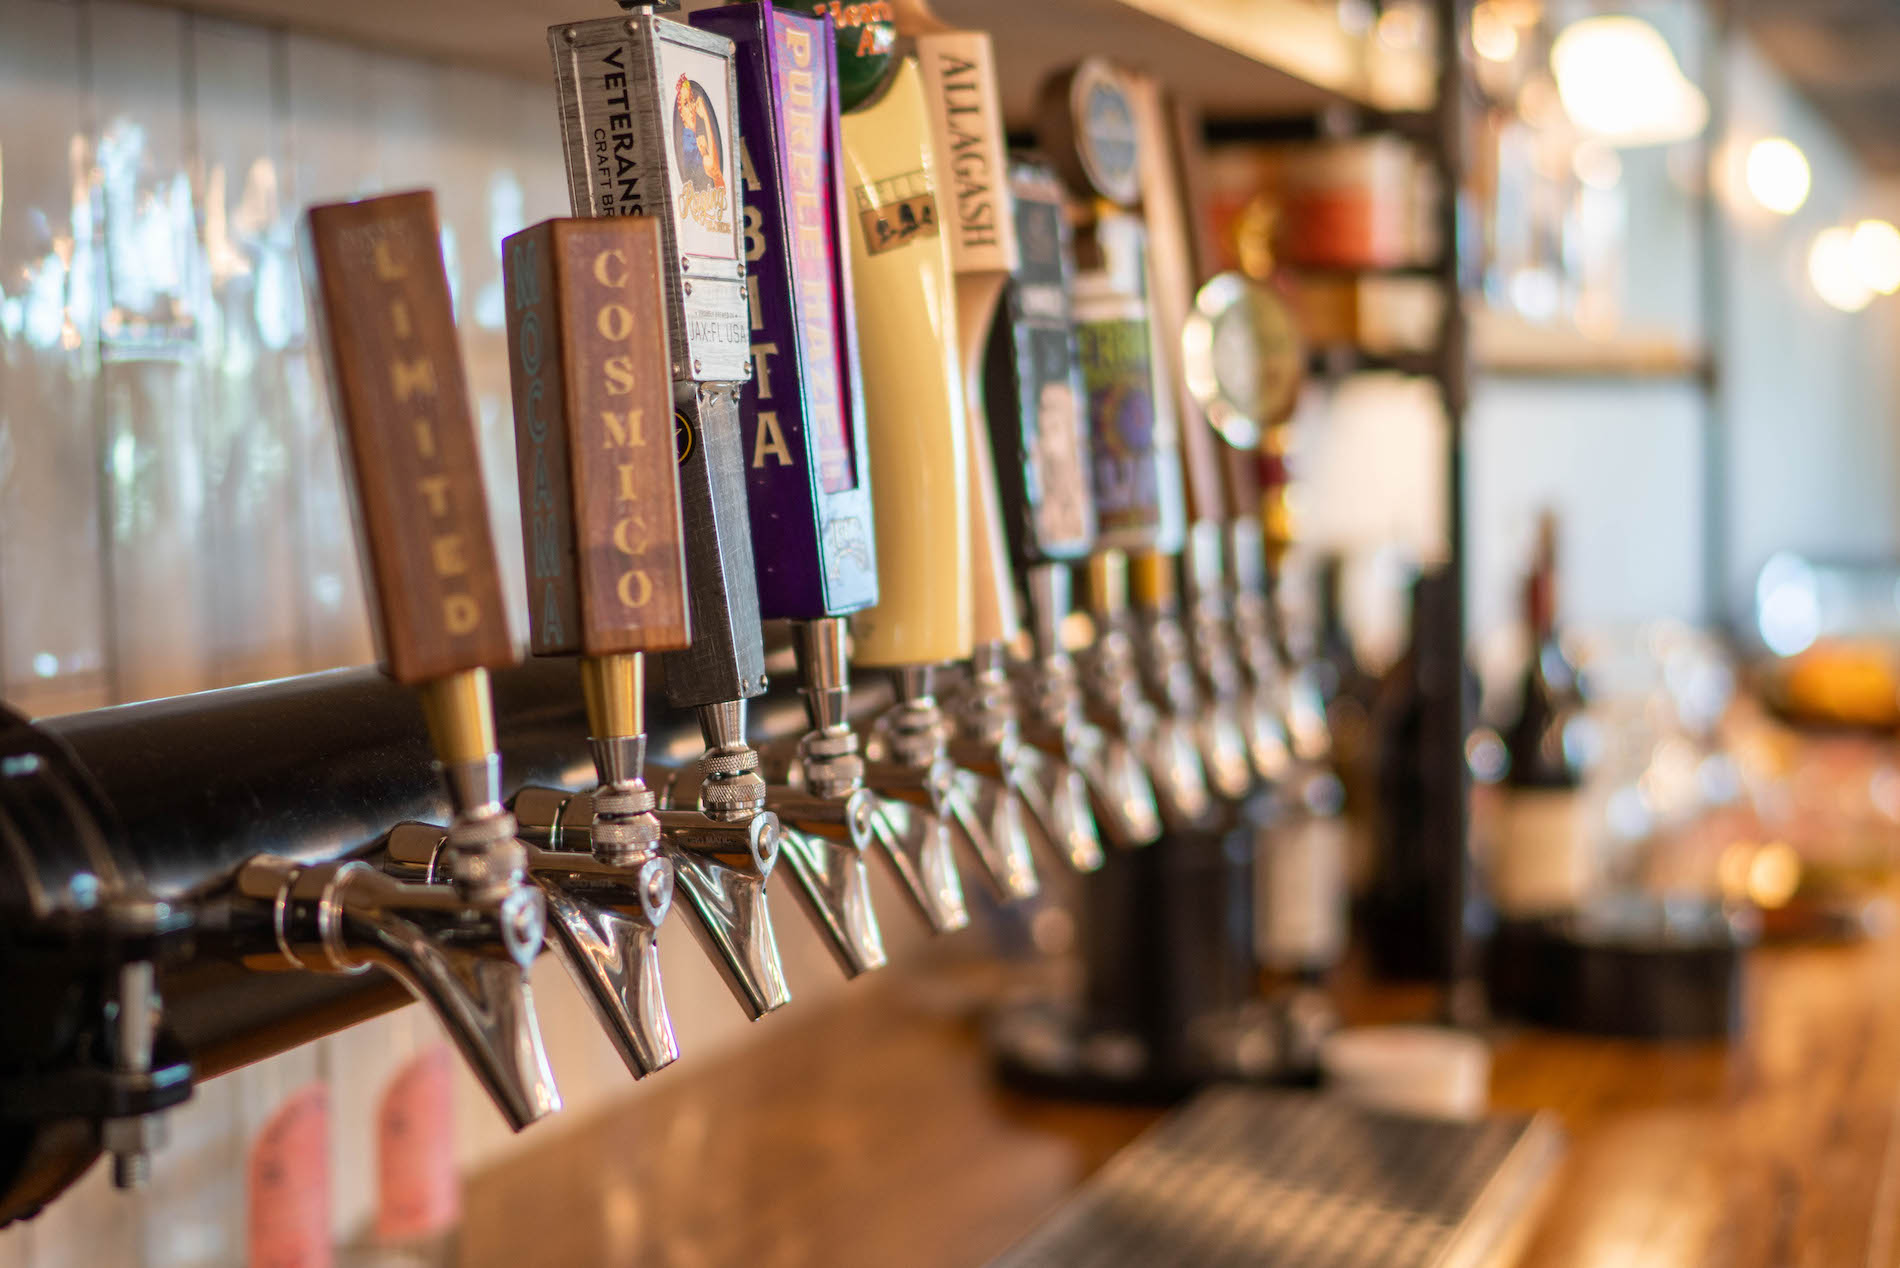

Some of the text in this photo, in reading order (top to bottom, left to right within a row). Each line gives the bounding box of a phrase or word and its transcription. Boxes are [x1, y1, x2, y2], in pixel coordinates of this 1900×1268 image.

[594, 128, 613, 189] CRAFT
[602, 46, 643, 217] VETERANS
[786, 27, 821, 260] PURPLE
[939, 53, 997, 246] ALLAGASH
[594, 249, 653, 609] COSMICO
[726, 322, 747, 344] USA
[802, 279, 839, 439] HAZE
[374, 239, 480, 635] LIMITED
[514, 240, 564, 646] MOCAMA
